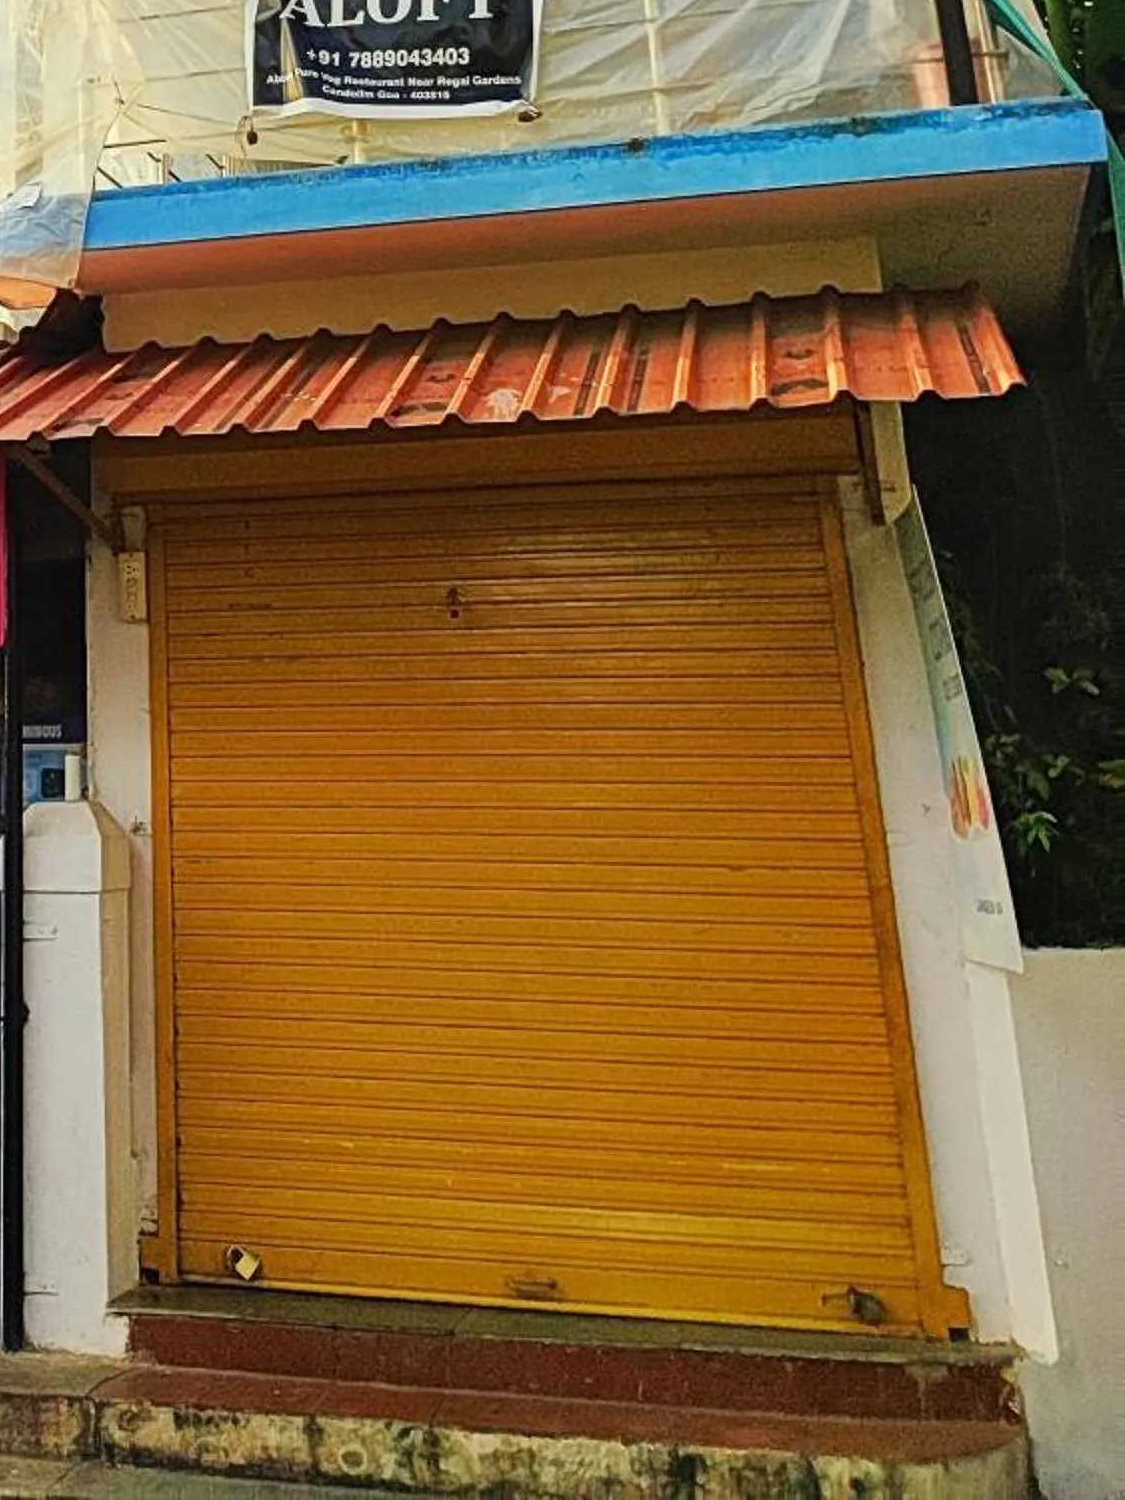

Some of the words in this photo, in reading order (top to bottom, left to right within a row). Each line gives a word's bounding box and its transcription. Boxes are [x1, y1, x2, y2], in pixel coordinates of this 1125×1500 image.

[306, 48, 341, 67] +91
[349, 47, 470, 69] 7889043403
[344, 75, 405, 87] Restaurant
[407, 77, 435, 87] Near
[436, 75, 470, 89] Regal
[472, 74, 522, 86] Gardens
[322, 84, 374, 99] Candolim
[376, 89, 400, 99] Goa
